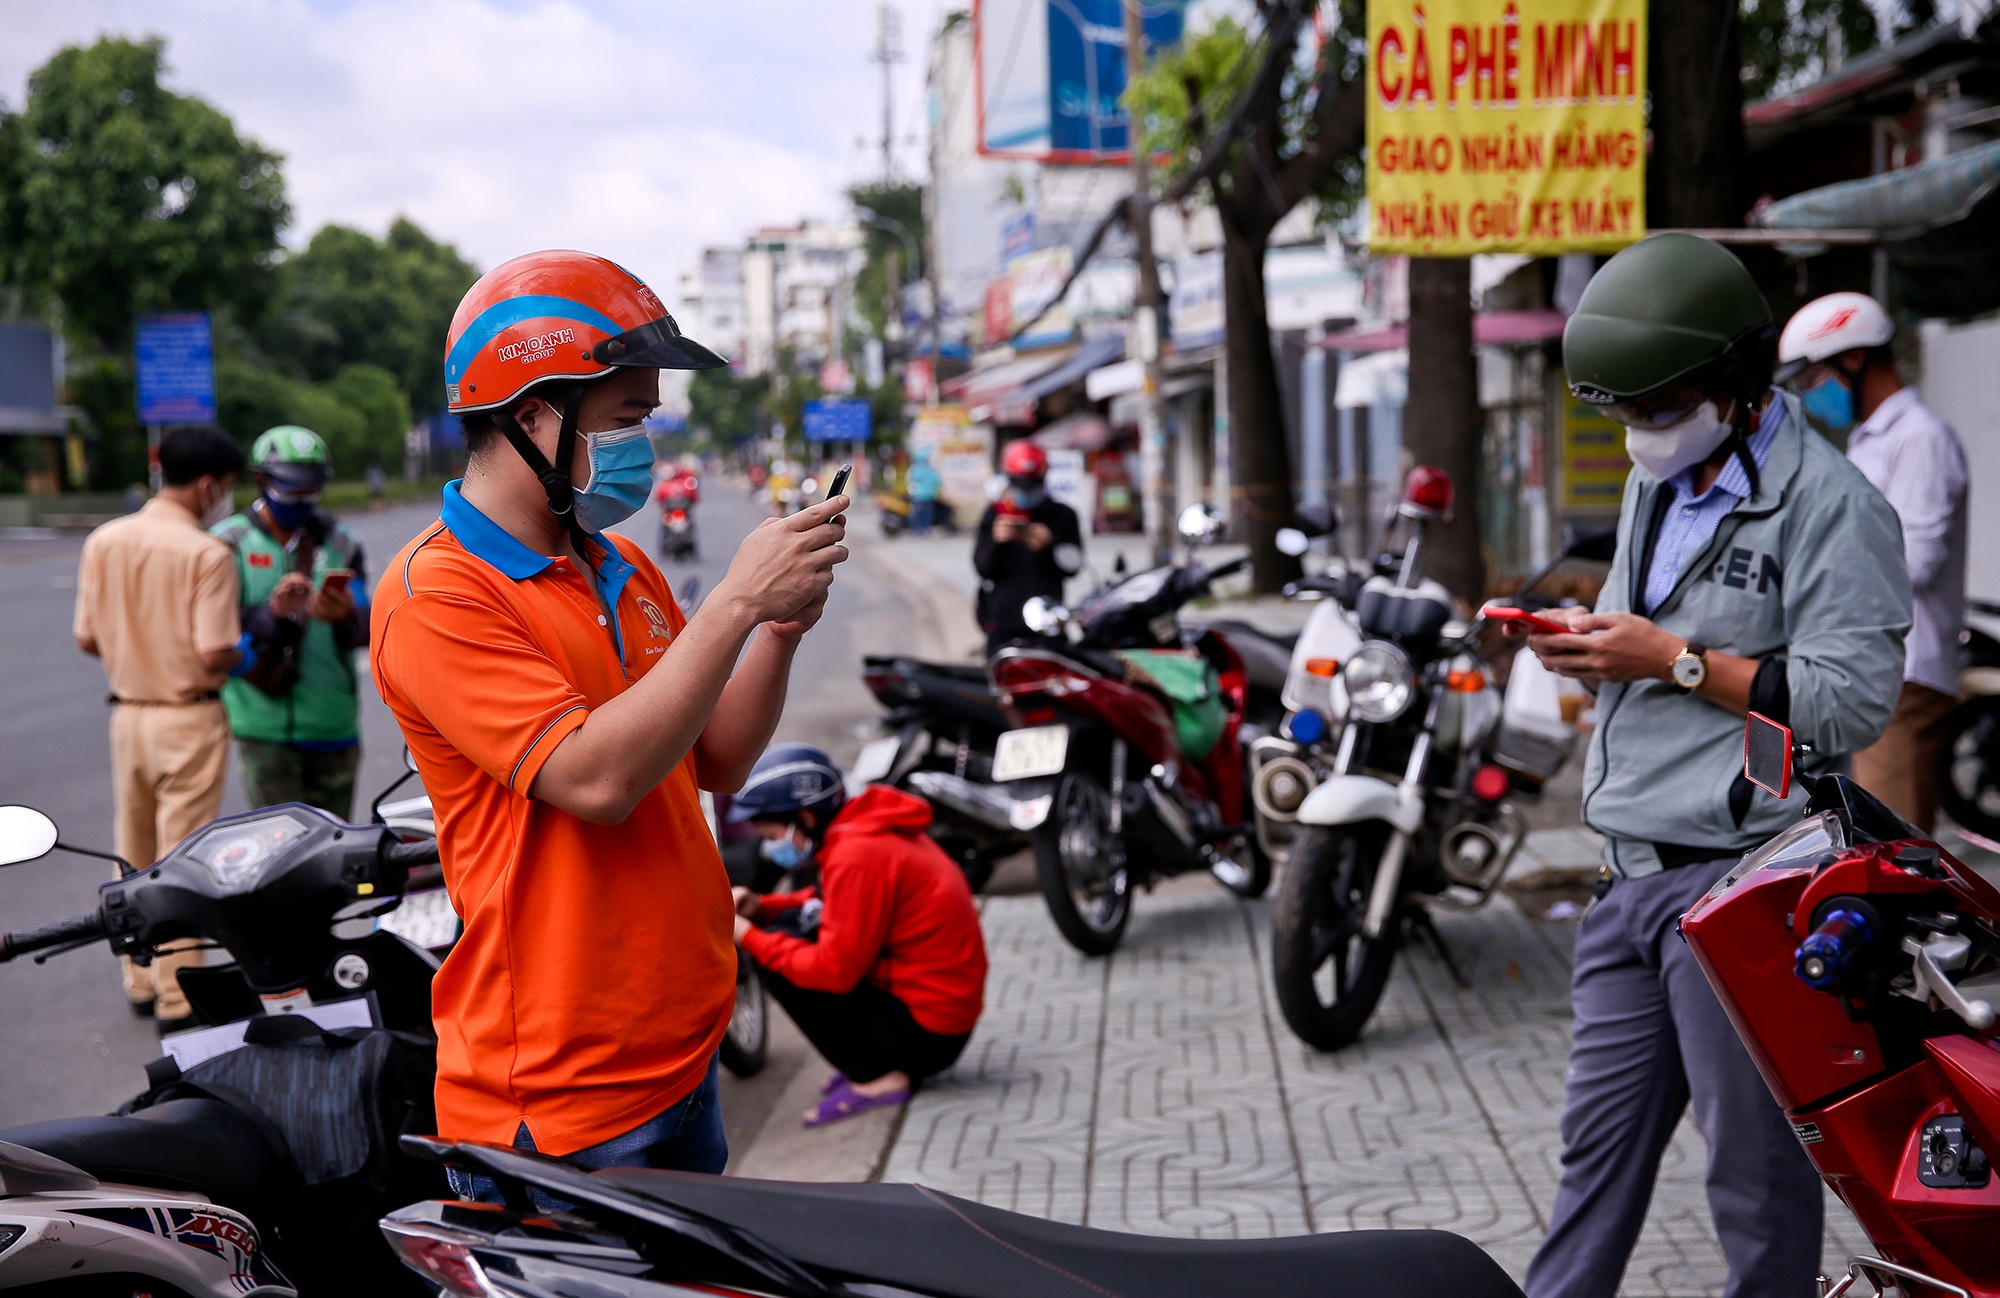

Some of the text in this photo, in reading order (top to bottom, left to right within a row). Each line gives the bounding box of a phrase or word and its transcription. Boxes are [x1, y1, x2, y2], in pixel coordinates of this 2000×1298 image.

[1376, 0, 1637, 112] CÀ PHÊ MINH
[1377, 136, 1453, 174] GIAO
[1460, 124, 1546, 184] NHẬN
[1377, 190, 1460, 254] NHẬN
[1529, 201, 1563, 239] XE
[1571, 186, 1636, 237] MÁY
[498, 327, 576, 362] KIM OANH
[521, 347, 556, 364] GROUP
